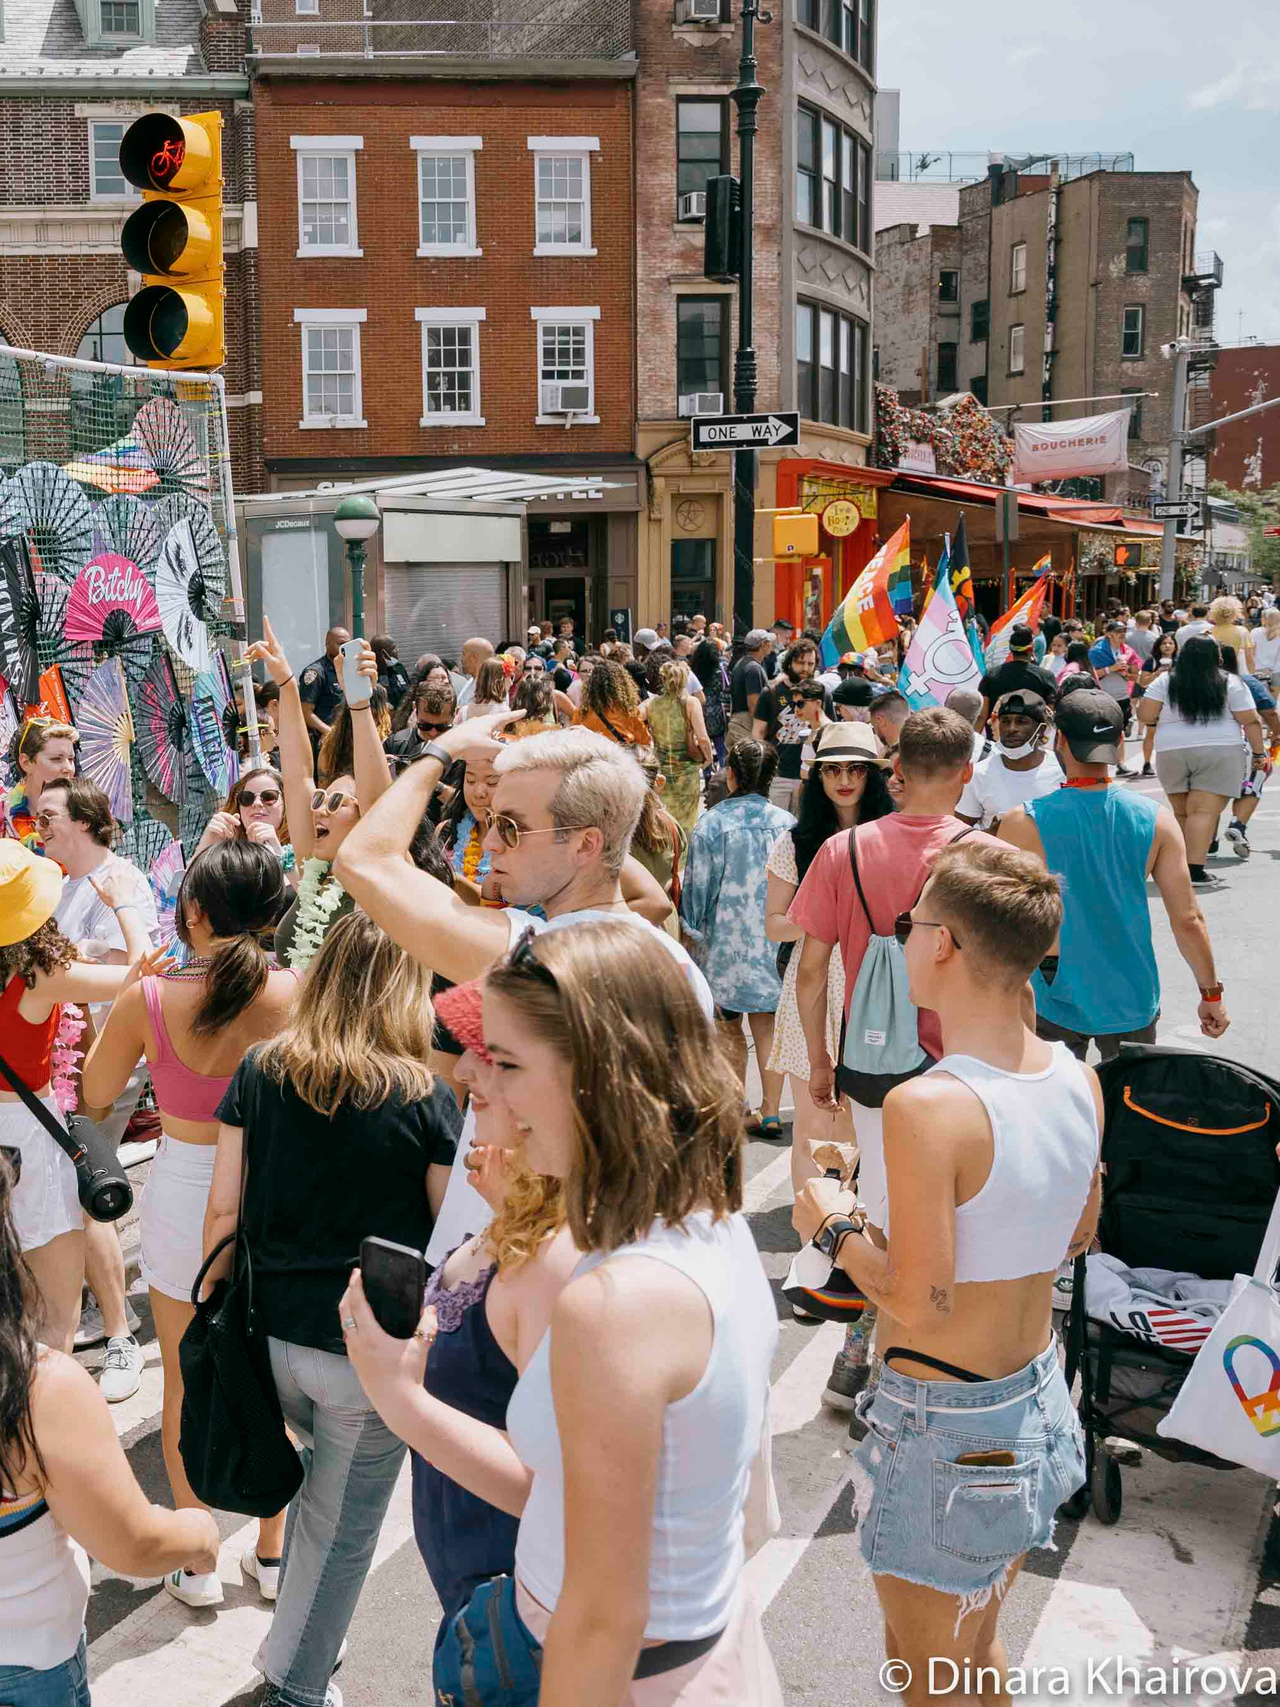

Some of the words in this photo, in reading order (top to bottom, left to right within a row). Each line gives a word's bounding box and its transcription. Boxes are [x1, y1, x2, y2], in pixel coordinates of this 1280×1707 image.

[708, 426, 737, 440] ONE
[751, 424, 782, 438] WAY
[1031, 435, 1108, 452] BOUCHERIE
[1157, 507, 1171, 515] ONE
[1179, 506, 1194, 514] WAY
[275, 520, 310, 529] JCDecaux
[84, 565, 144, 610] Bitchy
